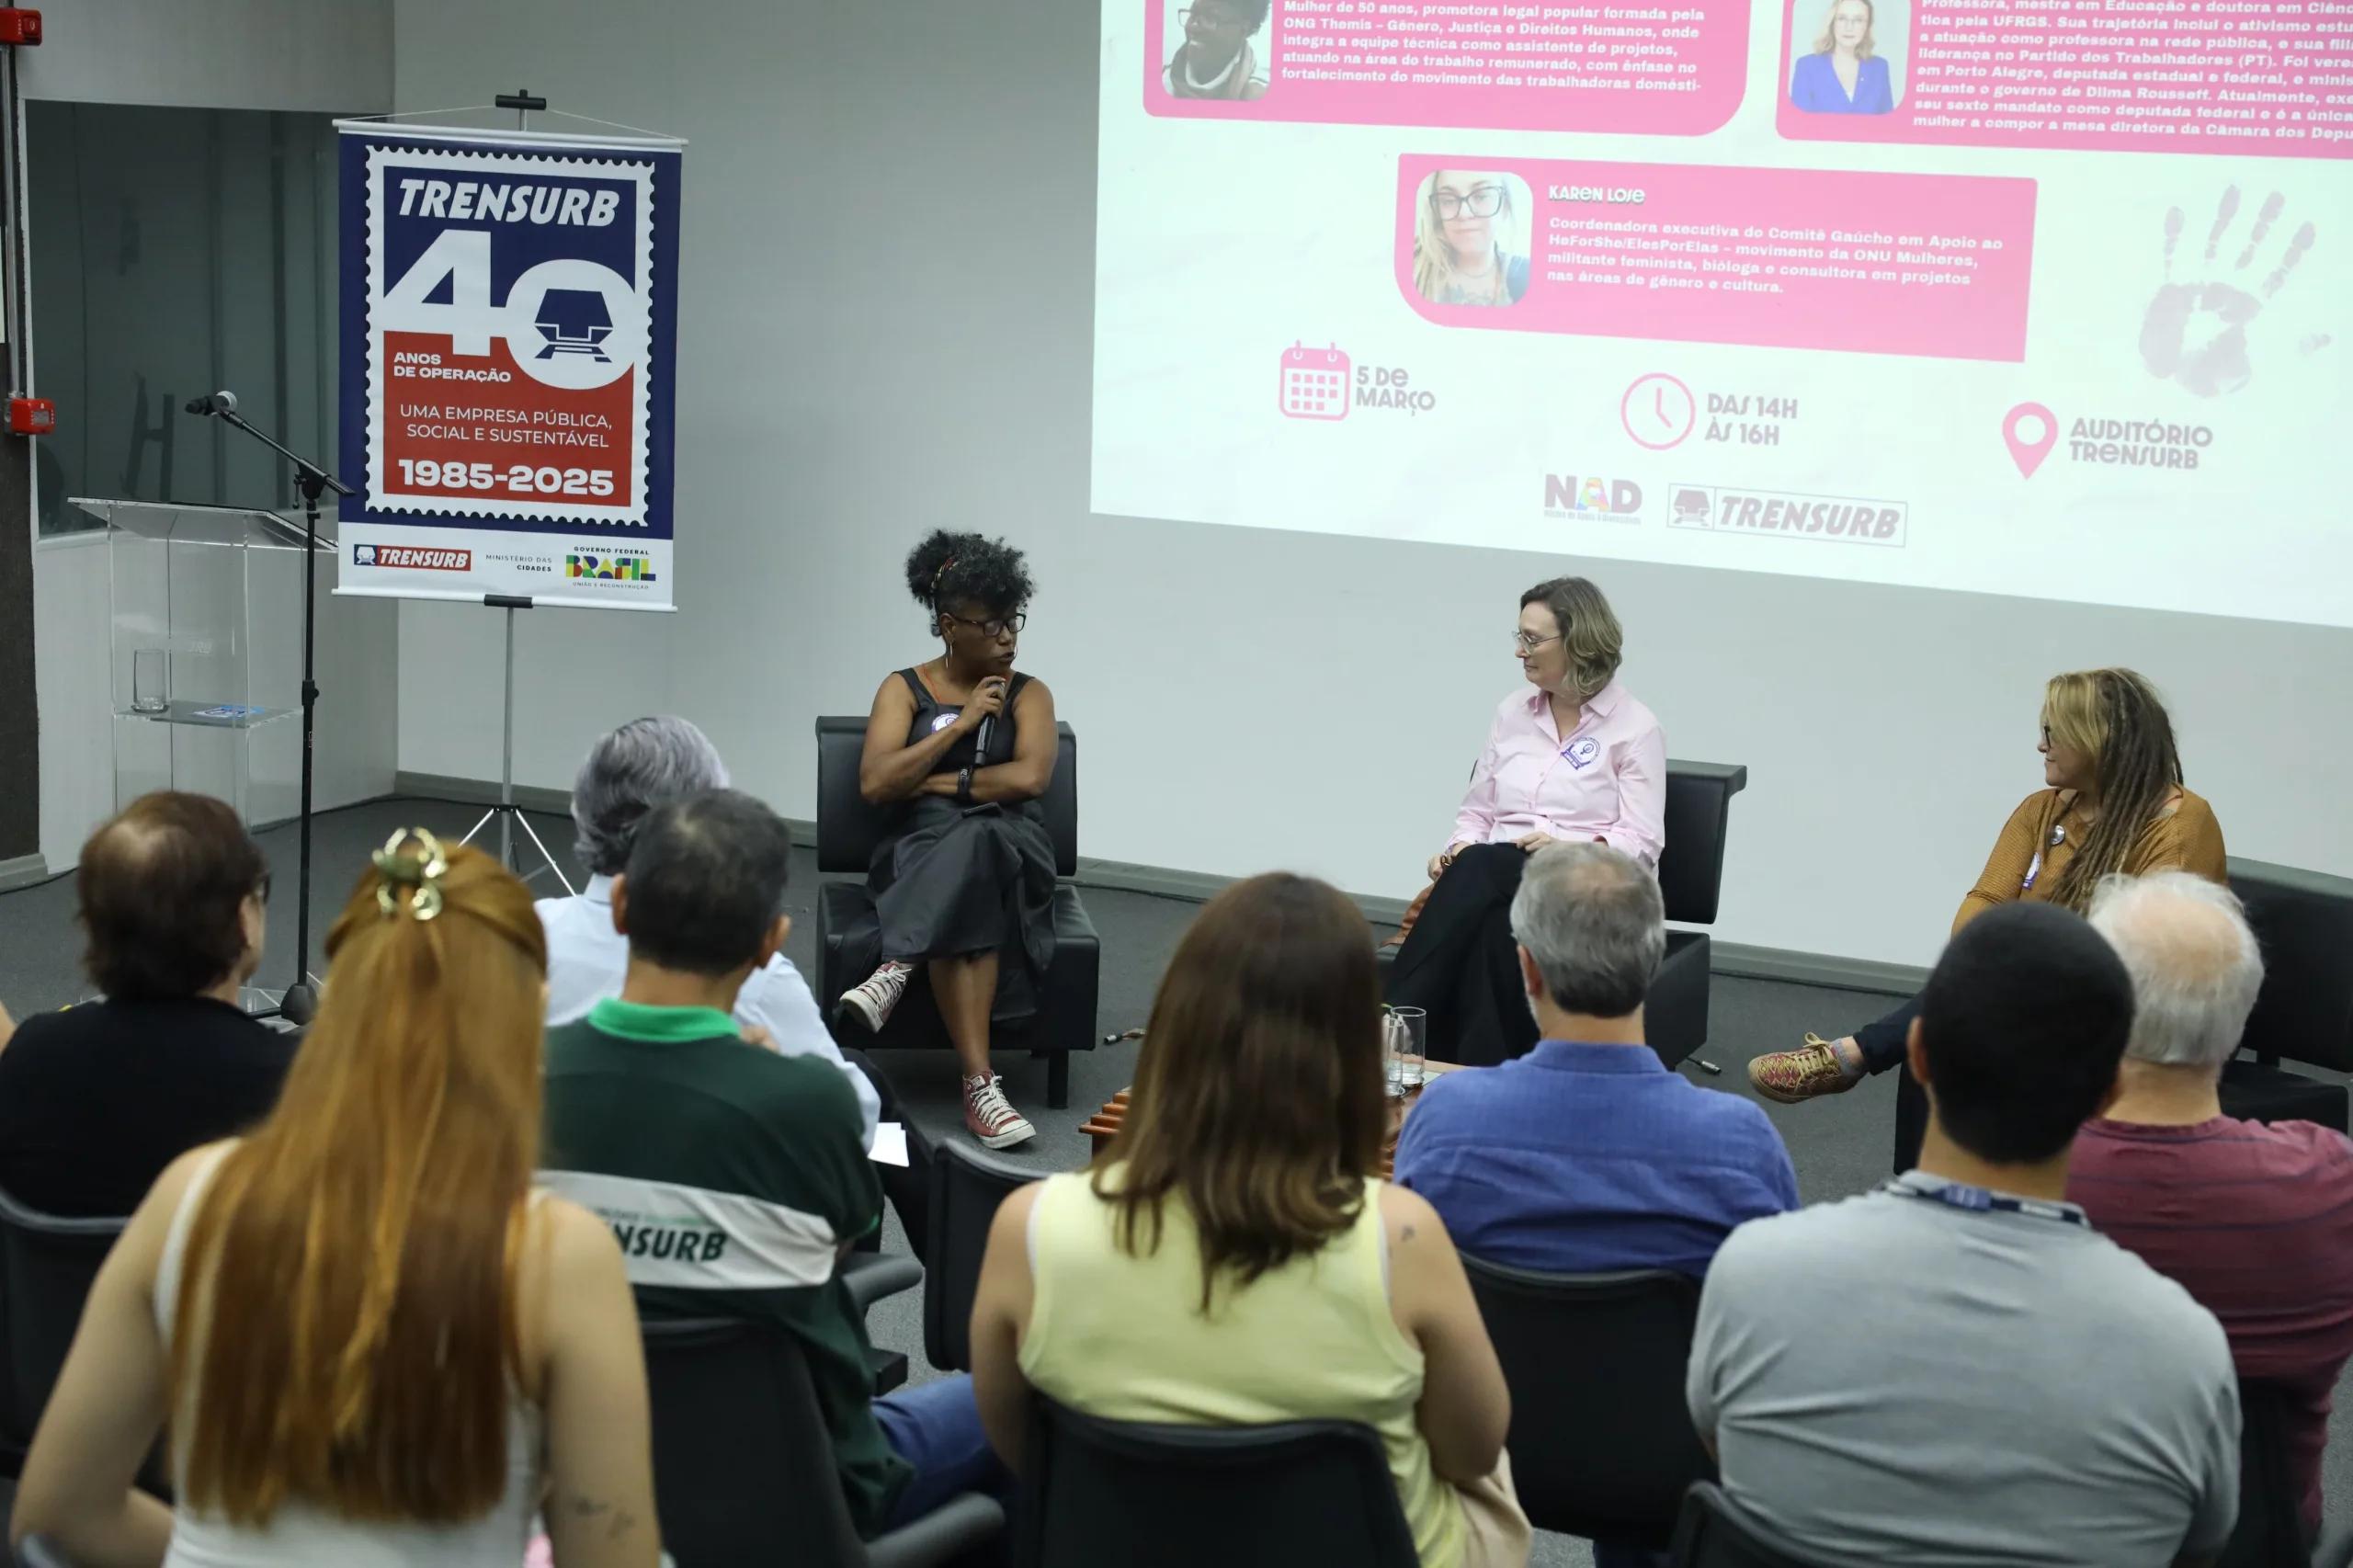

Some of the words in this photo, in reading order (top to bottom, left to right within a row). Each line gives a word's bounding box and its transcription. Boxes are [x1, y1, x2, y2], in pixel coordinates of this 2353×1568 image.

[1284, 0, 1332, 11] Mulher
[1336, 1, 1353, 12] de
[1358, 2, 1375, 13] 50
[1379, 5, 1417, 15] anos,
[1423, 6, 1498, 16] promotora
[1503, 5, 1539, 19] legal
[1543, 6, 1599, 19] popular
[1604, 6, 1666, 19] formada
[1671, 8, 1704, 22] pela
[2015, 0, 2070, 9] mestre
[2075, 1, 2099, 9] em
[2105, 0, 2186, 13] Educação
[2206, 1, 2270, 12] doutora
[2276, 4, 2302, 13] em
[1284, 17, 1315, 28] ONG
[1321, 17, 1371, 29] Themis
[1387, 19, 1443, 33] Gênero,
[1448, 21, 1502, 34] Justiça
[1519, 22, 1577, 34] Direitos
[1582, 25, 1656, 38] Humanos,
[1662, 26, 1699, 38] onde
[1921, 15, 1950, 25] tica
[1955, 16, 1987, 28] pela
[1994, 16, 2052, 27] UFRGS.
[2057, 17, 2086, 28] Sua
[2092, 17, 2167, 30] trajetória
[2174, 18, 2218, 29] inclui
[2239, 19, 2311, 31] ativismo
[1283, 34, 1334, 48] integra
[1351, 36, 1398, 49] equipe
[1403, 38, 1457, 49] técnica
[1461, 40, 1501, 50] como
[1506, 40, 1583, 51] assistente
[1587, 41, 1606, 52] de
[1610, 43, 1677, 56] projetos,
[1934, 32, 1995, 43] atuação
[2001, 35, 2043, 43] como
[2049, 34, 2134, 46] professora
[2140, 38, 2158, 46] na
[2165, 37, 2200, 47] rede
[2206, 37, 2272, 51] pública,
[2294, 40, 2324, 50] sua
[1282, 51, 1339, 62] atuando
[1344, 54, 1360, 63] na
[1365, 54, 1397, 64] área
[1402, 54, 1418, 65] do
[1423, 55, 1483, 66] trabalho
[1489, 59, 1581, 71] remunerado,
[1586, 62, 1618, 71] com
[1622, 60, 1673, 72] ênfase
[1918, 48, 1990, 61] liderança
[1995, 51, 2014, 60] no
[2019, 50, 2075, 61] Partido
[2081, 51, 2109, 62] dos
[2116, 51, 2233, 64] Trabalhadores
[2238, 54, 2276, 67] (PT).
[2283, 55, 2308, 66] Foi
[1282, 68, 1386, 81] fortalecimento
[1390, 71, 1407, 82] do
[1412, 73, 1491, 84] movimento
[1496, 74, 1521, 85] das
[1527, 75, 1631, 88] trabalhadoras
[1917, 66, 1939, 74] em
[1945, 64, 1987, 76] Porto
[1992, 66, 2047, 80] Alegre,
[2052, 68, 2127, 81] deputada
[2132, 71, 2202, 81] estadual
[2223, 72, 2287, 85] federal,
[1915, 82, 1974, 93] durante
[1994, 85, 2056, 97] governo
[2062, 85, 2081, 96] de
[2086, 86, 2131, 97] Dilma
[2217, 90, 2319, 104] Atualmente,
[1915, 100, 1941, 108] seu
[1947, 100, 1988, 110] sexto
[1994, 102, 2062, 112] mandato
[2066, 105, 2110, 114] como
[2115, 105, 2191, 117] deputada
[2197, 107, 2255, 119] federal
[1914, 116, 1965, 126] mulher
[1984, 119, 2043, 131] compor
[2063, 121, 2105, 131] mesa
[2110, 121, 2175, 133] diretora
[2180, 123, 2200, 134] da
[2206, 124, 2269, 136] Câmara
[2275, 126, 2305, 137] dos
[399, 178, 620, 226] TRENSURB
[1550, 218, 1657, 233] Coordenadora
[1663, 224, 1739, 236] executiva
[1744, 226, 1763, 237] do
[1768, 228, 1825, 240] Comitê
[1831, 231, 1893, 244] Gaúcho
[1898, 235, 1923, 244] em
[1928, 235, 1976, 248] Apoio
[1982, 240, 2002, 248] ao
[1735, 245, 1824, 257] movimento
[1829, 247, 1848, 259] da
[1854, 249, 1891, 261] ONU
[1896, 252, 1977, 267] Mulheres,
[1548, 252, 1616, 265] militante
[1620, 256, 1697, 271] feminista,
[1702, 259, 1759, 276] bióloga
[1779, 266, 1866, 278] consultora
[1871, 270, 1896, 279] em
[1902, 271, 1970, 284] projetos
[1547, 271, 1574, 280] nas
[1578, 271, 1620, 283] áreas
[1626, 273, 1644, 284] de
[1649, 276, 1703, 288] gênero
[1722, 279, 1783, 292] cultura.
[383, 229, 635, 390] 40
[393, 352, 441, 365] ANOS
[393, 366, 416, 378] DE
[419, 368, 511, 382] OPERAÇÃO
[1356, 366, 1370, 385] 5
[1356, 387, 1436, 416] MARÇO
[1708, 393, 1750, 415] DAS
[1756, 396, 1798, 419] 14H
[400, 404, 440, 419] UMA
[446, 407, 528, 424] EMPRESA
[534, 410, 612, 429] PÚBLICA,
[407, 424, 470, 440] SOCIAL
[475, 426, 484, 440] E
[489, 429, 608, 448] SUSTENTÁVEL
[1739, 423, 1779, 446] 16H
[2070, 417, 2213, 448] AUDITÓRIO
[399, 460, 614, 495] 1985-2025
[1544, 473, 1643, 514] NAD
[1719, 494, 1901, 539] TRENSURB
[380, 549, 469, 568] TRENSURB
[485, 554, 533, 562] MINISTÉRIO
[565, 554, 656, 581] BRASIL
[610, 1222, 728, 1262] NSURB
